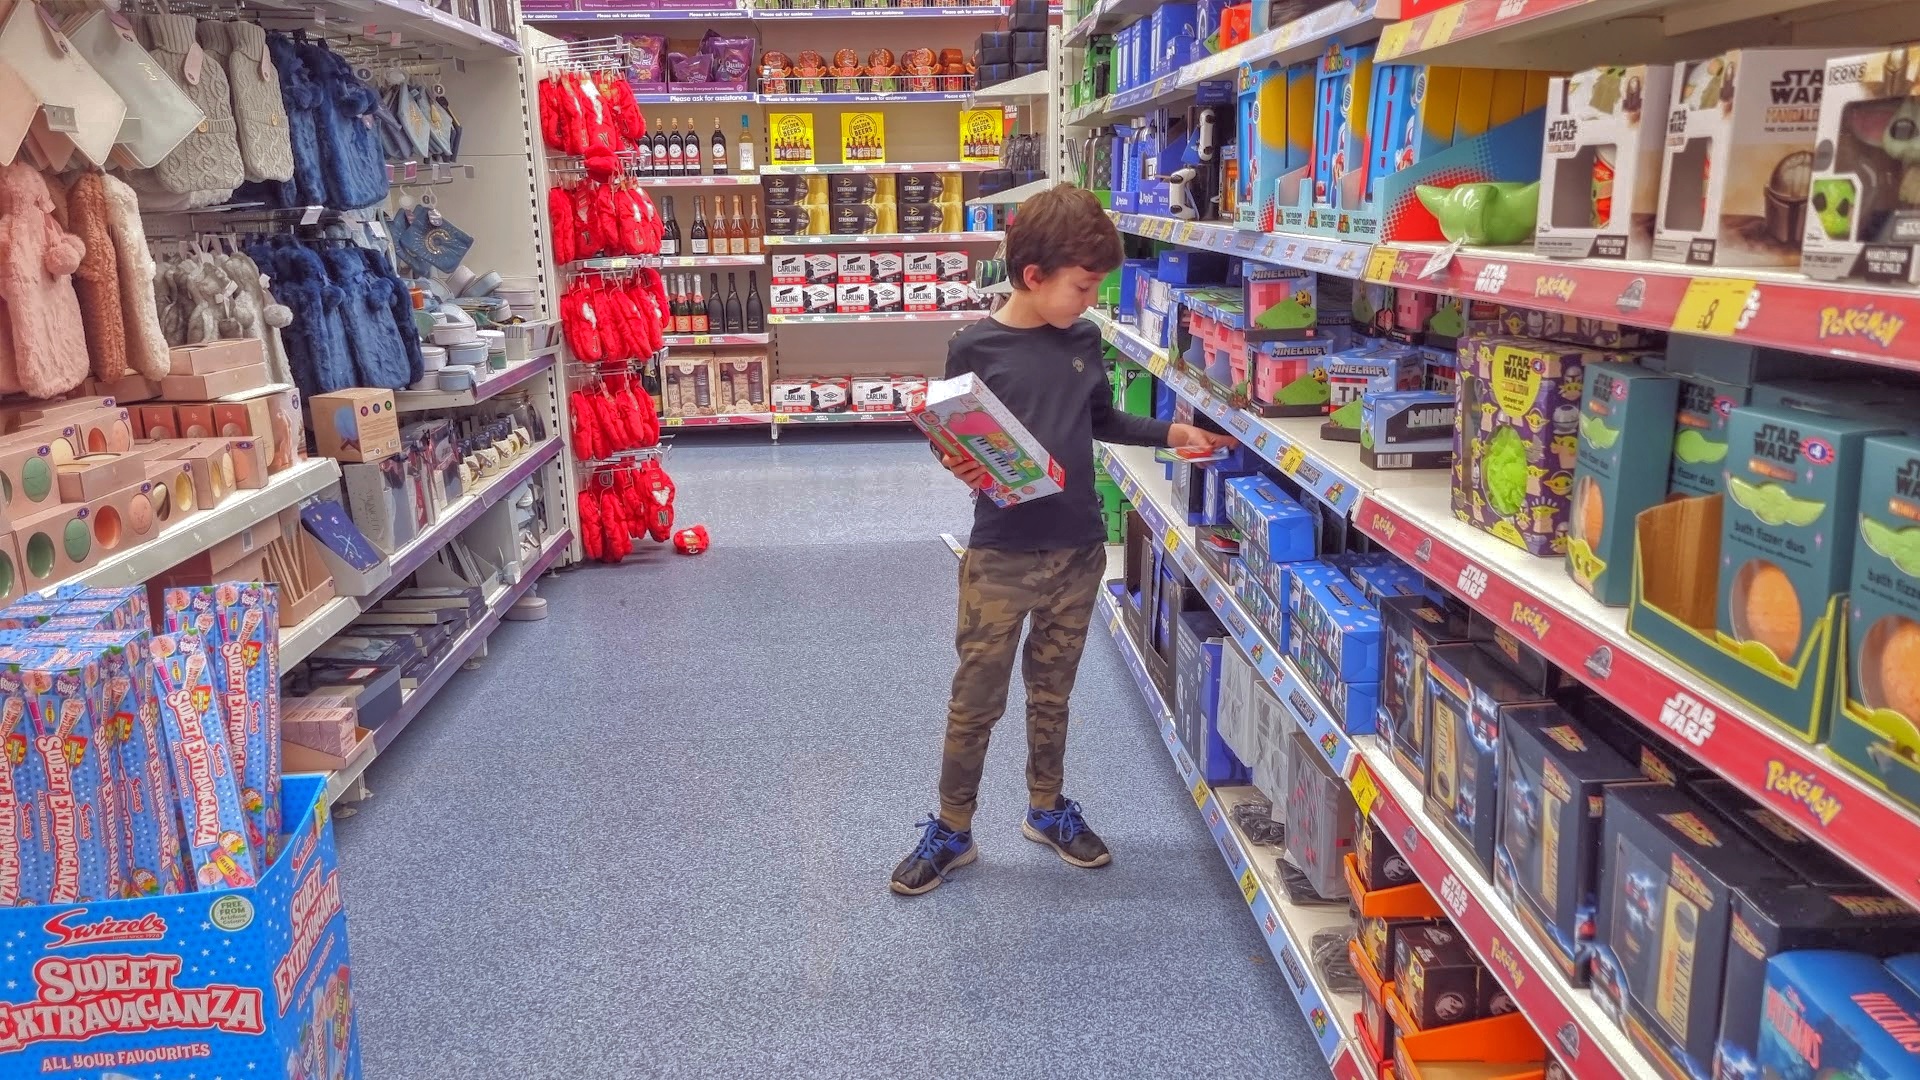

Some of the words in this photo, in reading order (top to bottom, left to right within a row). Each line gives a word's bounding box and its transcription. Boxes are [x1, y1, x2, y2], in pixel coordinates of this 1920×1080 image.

[1770, 70, 1824, 88] STA
[1828, 64, 1866, 84] ICONS
[704, 94, 714, 102] for
[782, 120, 801, 132] GOLDEN
[782, 127, 802, 138] BEERS
[852, 121, 870, 131] GOLDEN
[854, 126, 872, 137] BEERS
[972, 119, 990, 130] GOLDEN
[972, 124, 991, 134] BEERS
[1548, 120, 1577, 132] STAR
[1548, 131, 1577, 142] WARS
[777, 264, 800, 273] CARLING
[843, 264, 866, 272] CARLING
[908, 262, 932, 270] CARLING
[1251, 268, 1310, 281] MINECRAFT
[775, 295, 798, 303] CARLING
[841, 294, 864, 302] CARLING
[908, 292, 932, 300] CARLING
[1818, 304, 1906, 347] Pokémon
[1272, 346, 1328, 358] MINECRAFT
[1504, 354, 1530, 366] STAR
[1328, 364, 1390, 377] MINECRAFT
[1503, 366, 1530, 382] WARS
[784, 393, 806, 402] CARLING
[866, 392, 888, 401] CARLING
[1755, 424, 1800, 444] STAR
[1754, 439, 1801, 464] WARS
[1734, 520, 1755, 536] bath
[1757, 527, 1784, 546] fizzer
[1786, 538, 1806, 554] duo
[1462, 564, 1488, 588] STAR
[1867, 568, 1892, 587] bath
[1457, 576, 1485, 600] WARS
[1510, 602, 1550, 640] Pokémon
[168, 690, 203, 742] SWEET
[1665, 692, 1716, 730] STAR
[1658, 704, 1716, 747] WARS
[36, 736, 70, 794] SWEET
[182, 740, 220, 847] EXTRAVAGANZA
[1764, 759, 1842, 827] Pokémon
[102, 781, 120, 899] EXTRAVAGANZA
[1442, 874, 1468, 902] STAR
[221, 901, 243, 909] FREE
[293, 861, 320, 936] SWEET
[1440, 885, 1468, 918] WARS
[220, 908, 246, 916] FROM
[45, 908, 168, 948] Swizzels
[278, 870, 340, 1015] EXTRAVAGANZA
[1491, 936, 1525, 990] Pokémon
[38, 956, 181, 1003] SWEET
[1670, 945, 1692, 1035] OUTATIME
[0, 988, 262, 1048] EXTRAVAGANZA
[42, 1057, 72, 1073] ALL
[73, 1053, 116, 1070] YOUR
[118, 1044, 212, 1066] FAVOURITES
